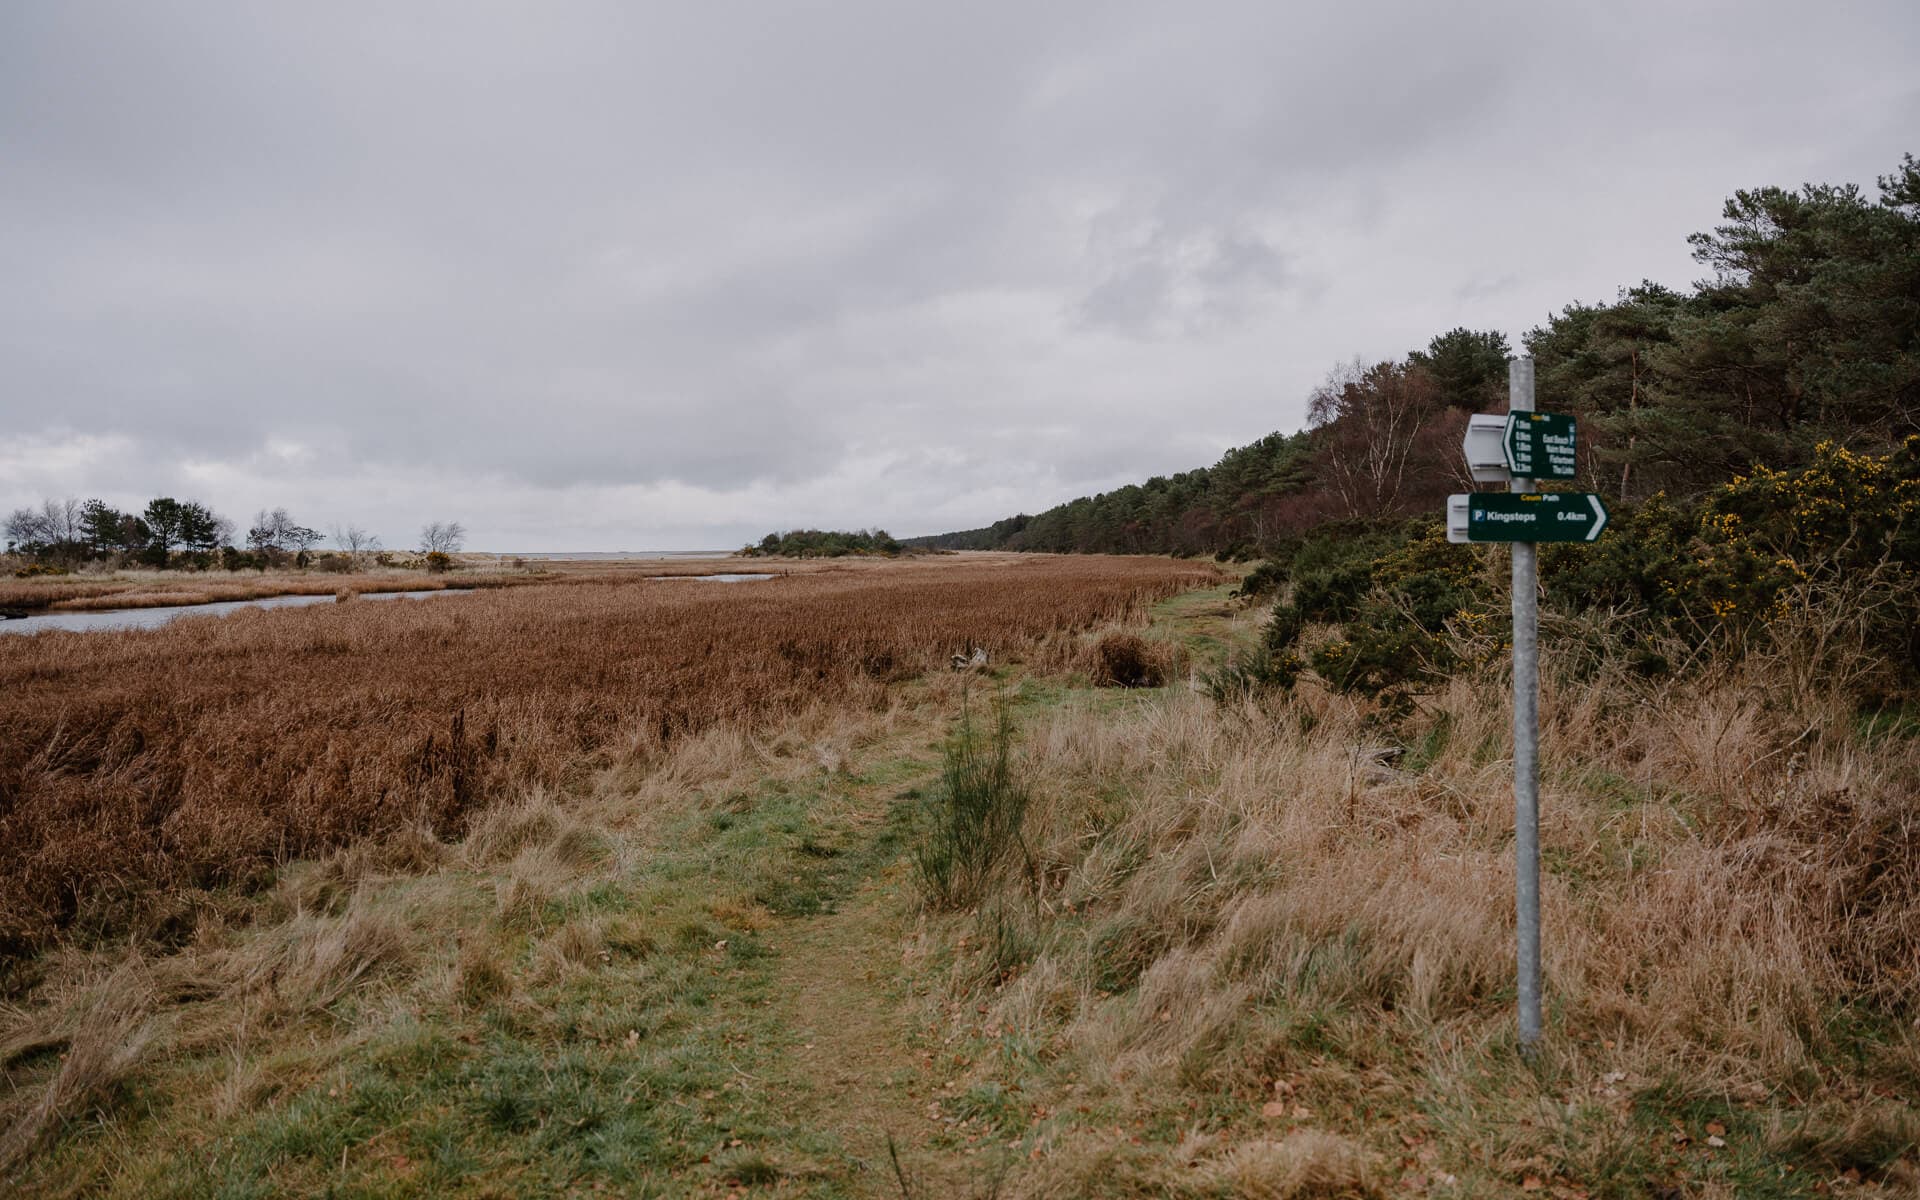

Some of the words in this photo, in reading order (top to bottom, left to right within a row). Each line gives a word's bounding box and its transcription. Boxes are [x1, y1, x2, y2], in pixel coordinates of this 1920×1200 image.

[1543, 494, 1560, 502] Path
[1475, 511, 1483, 520] P
[1487, 511, 1536, 523] Kingsteps
[1557, 511, 1587, 521] 0.4km
